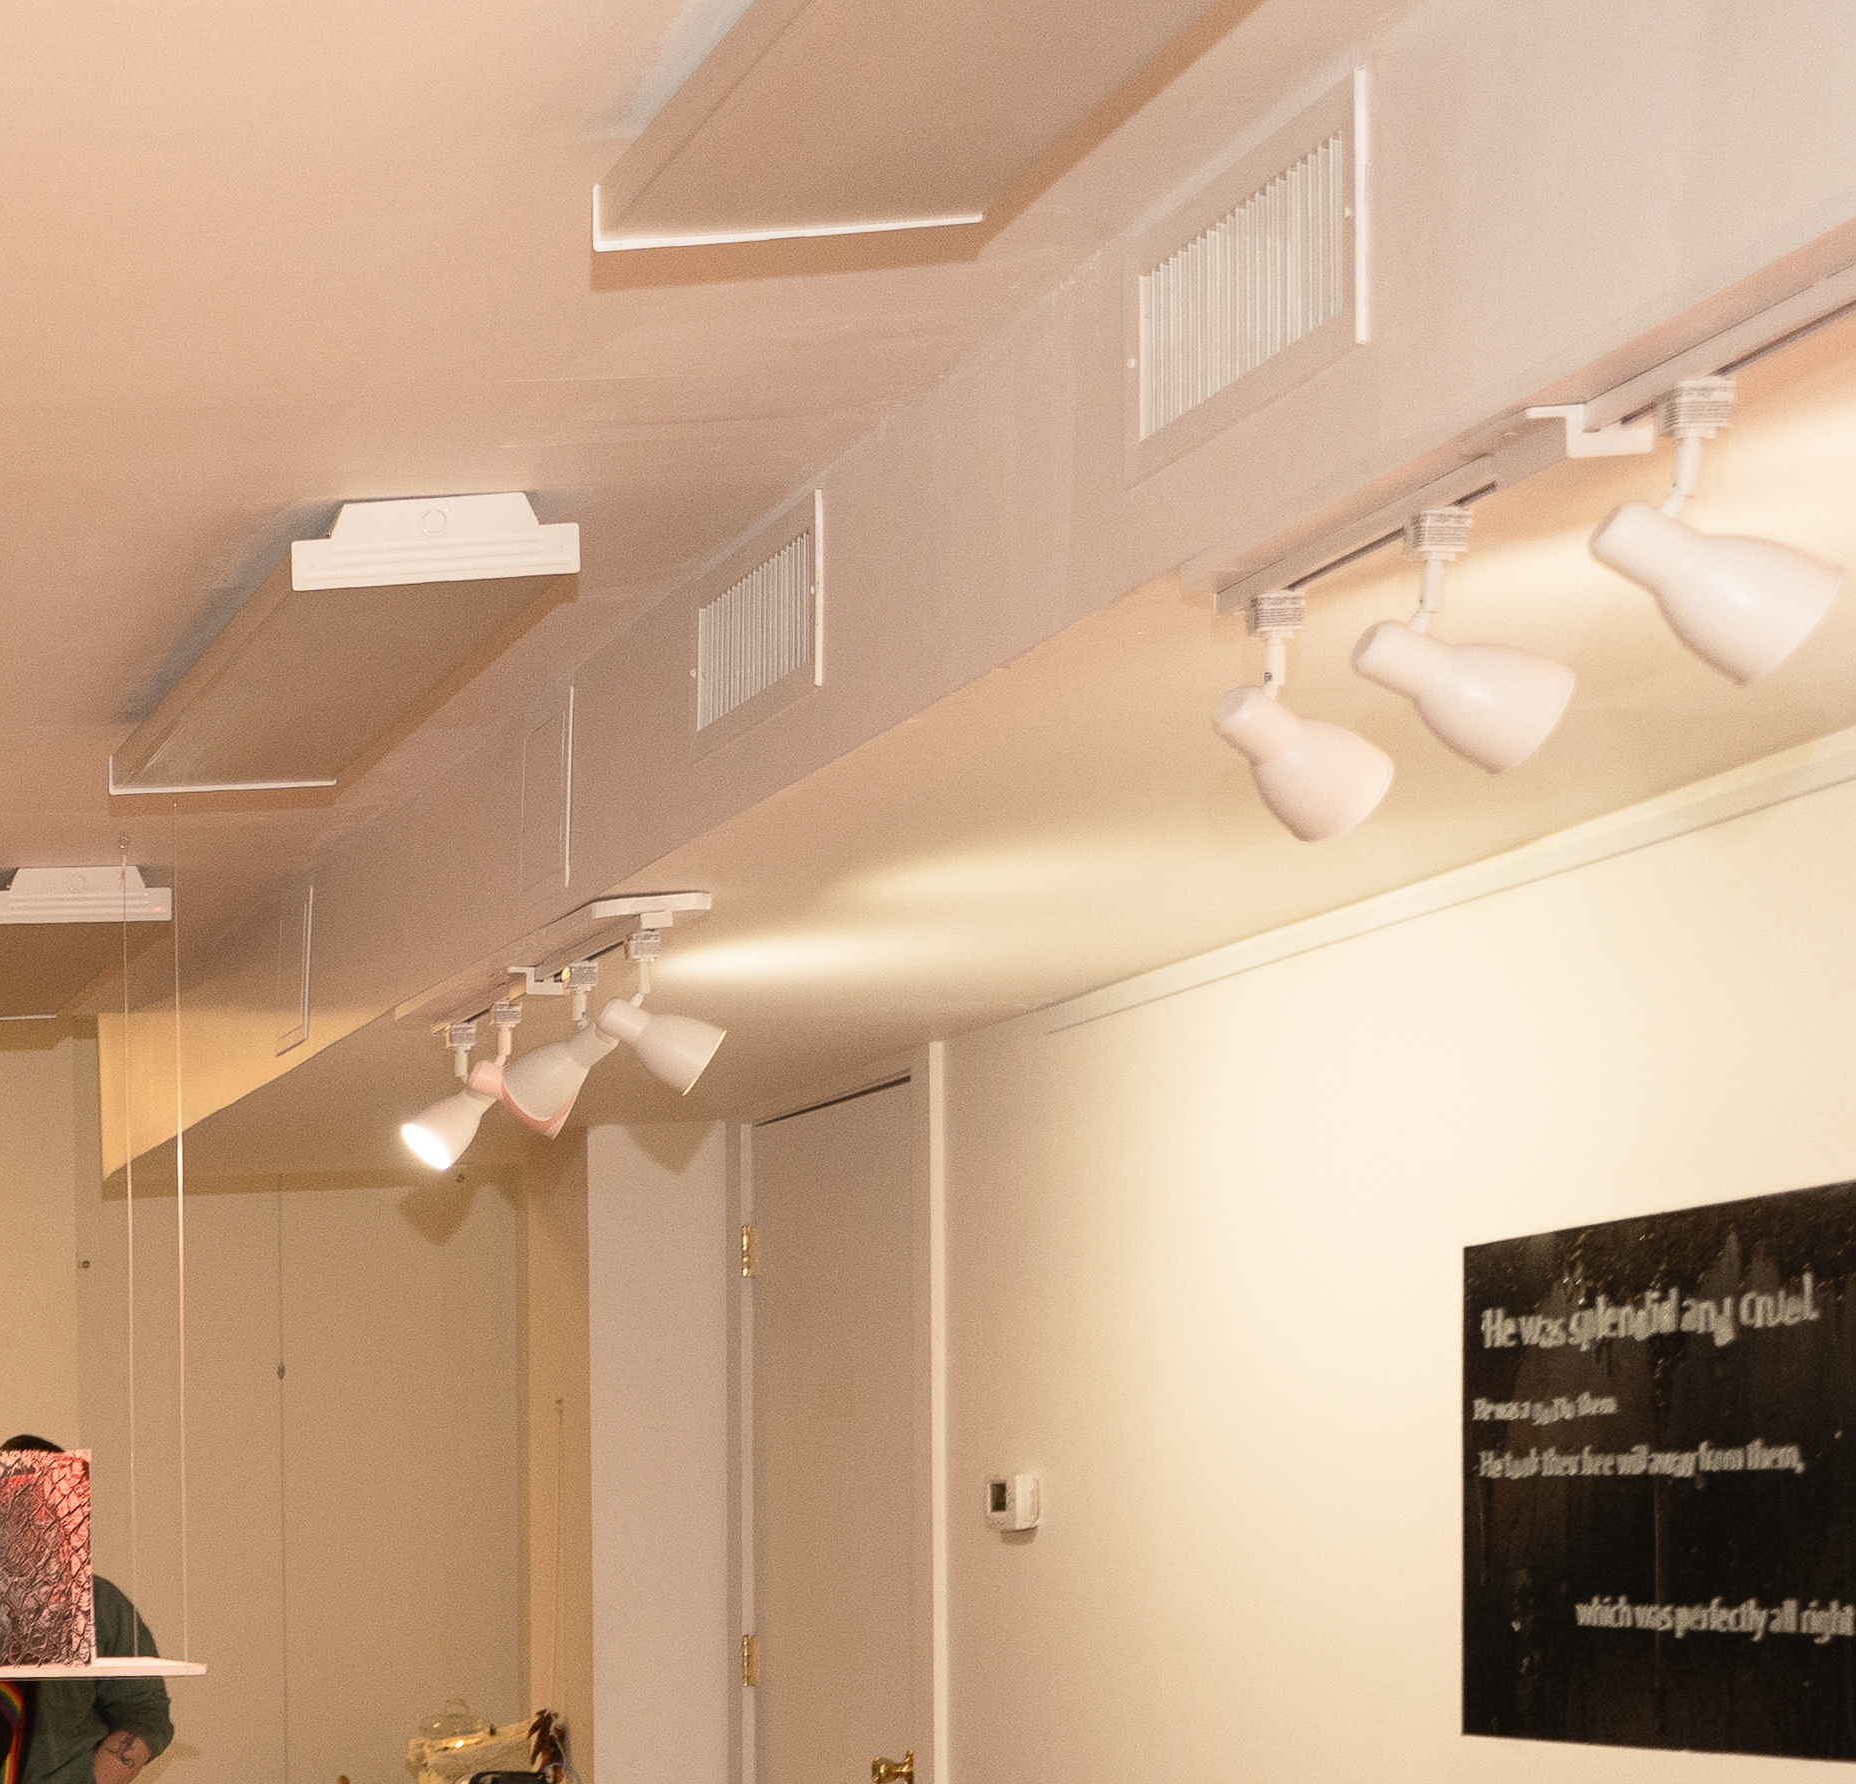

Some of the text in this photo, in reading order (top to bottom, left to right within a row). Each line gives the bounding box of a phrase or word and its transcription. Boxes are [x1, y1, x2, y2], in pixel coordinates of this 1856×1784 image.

[1481, 1308, 1518, 1348] He
[1519, 1315, 1567, 1348] was
[1478, 1450, 1504, 1479] He
[1574, 1595, 1634, 1629] which
[1634, 1604, 1674, 1632] was
[1673, 1596, 1769, 1643] perfectly
[1769, 1597, 1800, 1633] all
